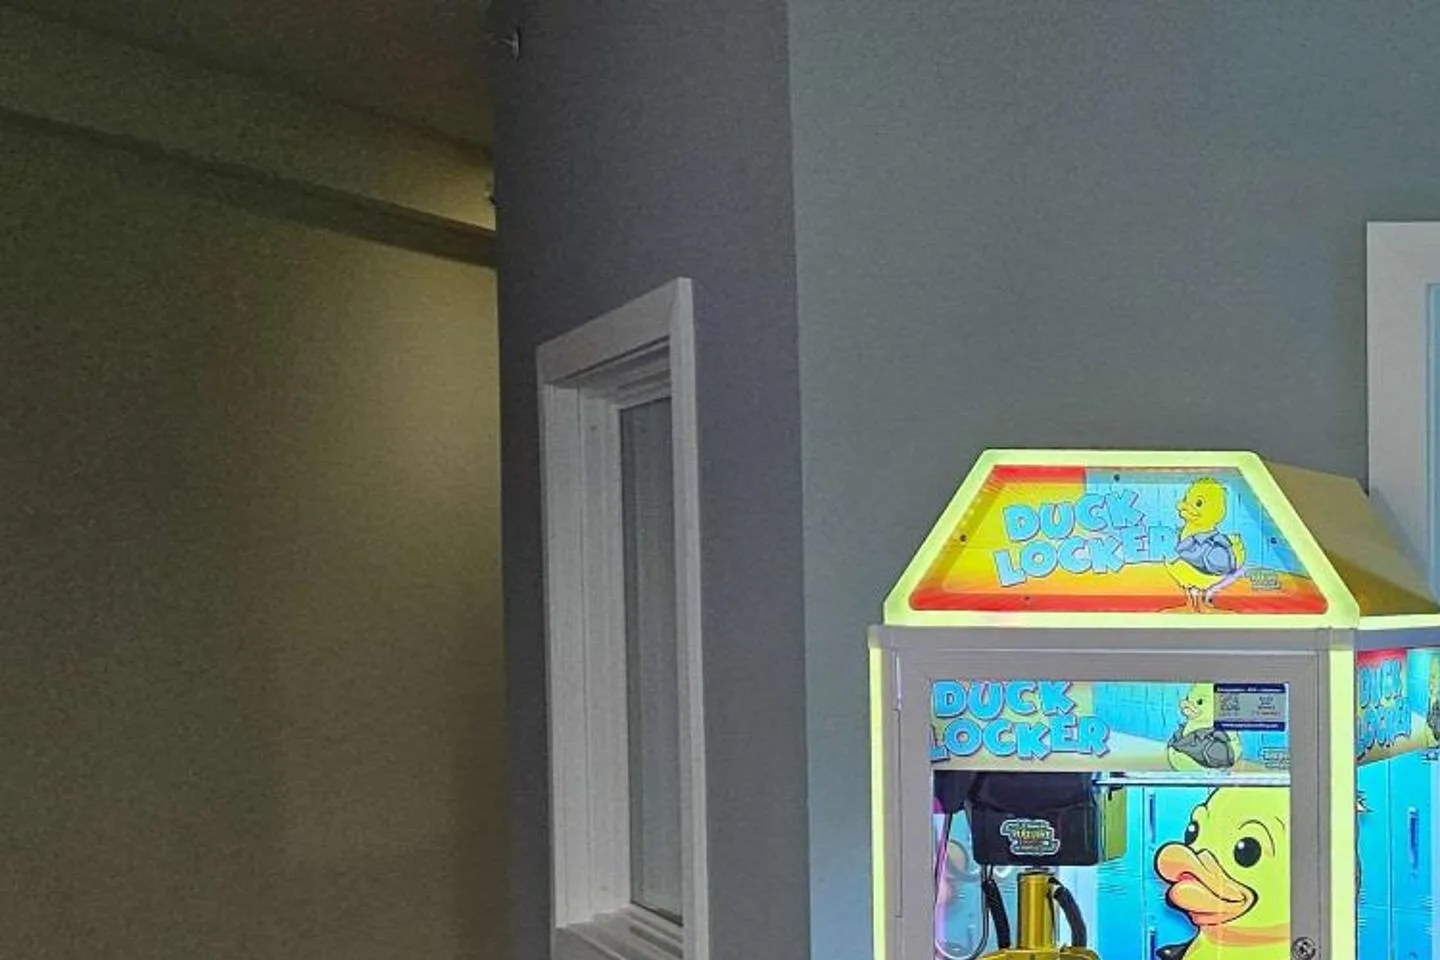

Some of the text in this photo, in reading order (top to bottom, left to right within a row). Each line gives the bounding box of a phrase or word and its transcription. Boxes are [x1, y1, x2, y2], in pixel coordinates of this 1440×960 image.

[1002, 488, 1146, 544] DUCK
[993, 523, 1180, 587] LOCKER
[931, 679, 1077, 719] DUCK
